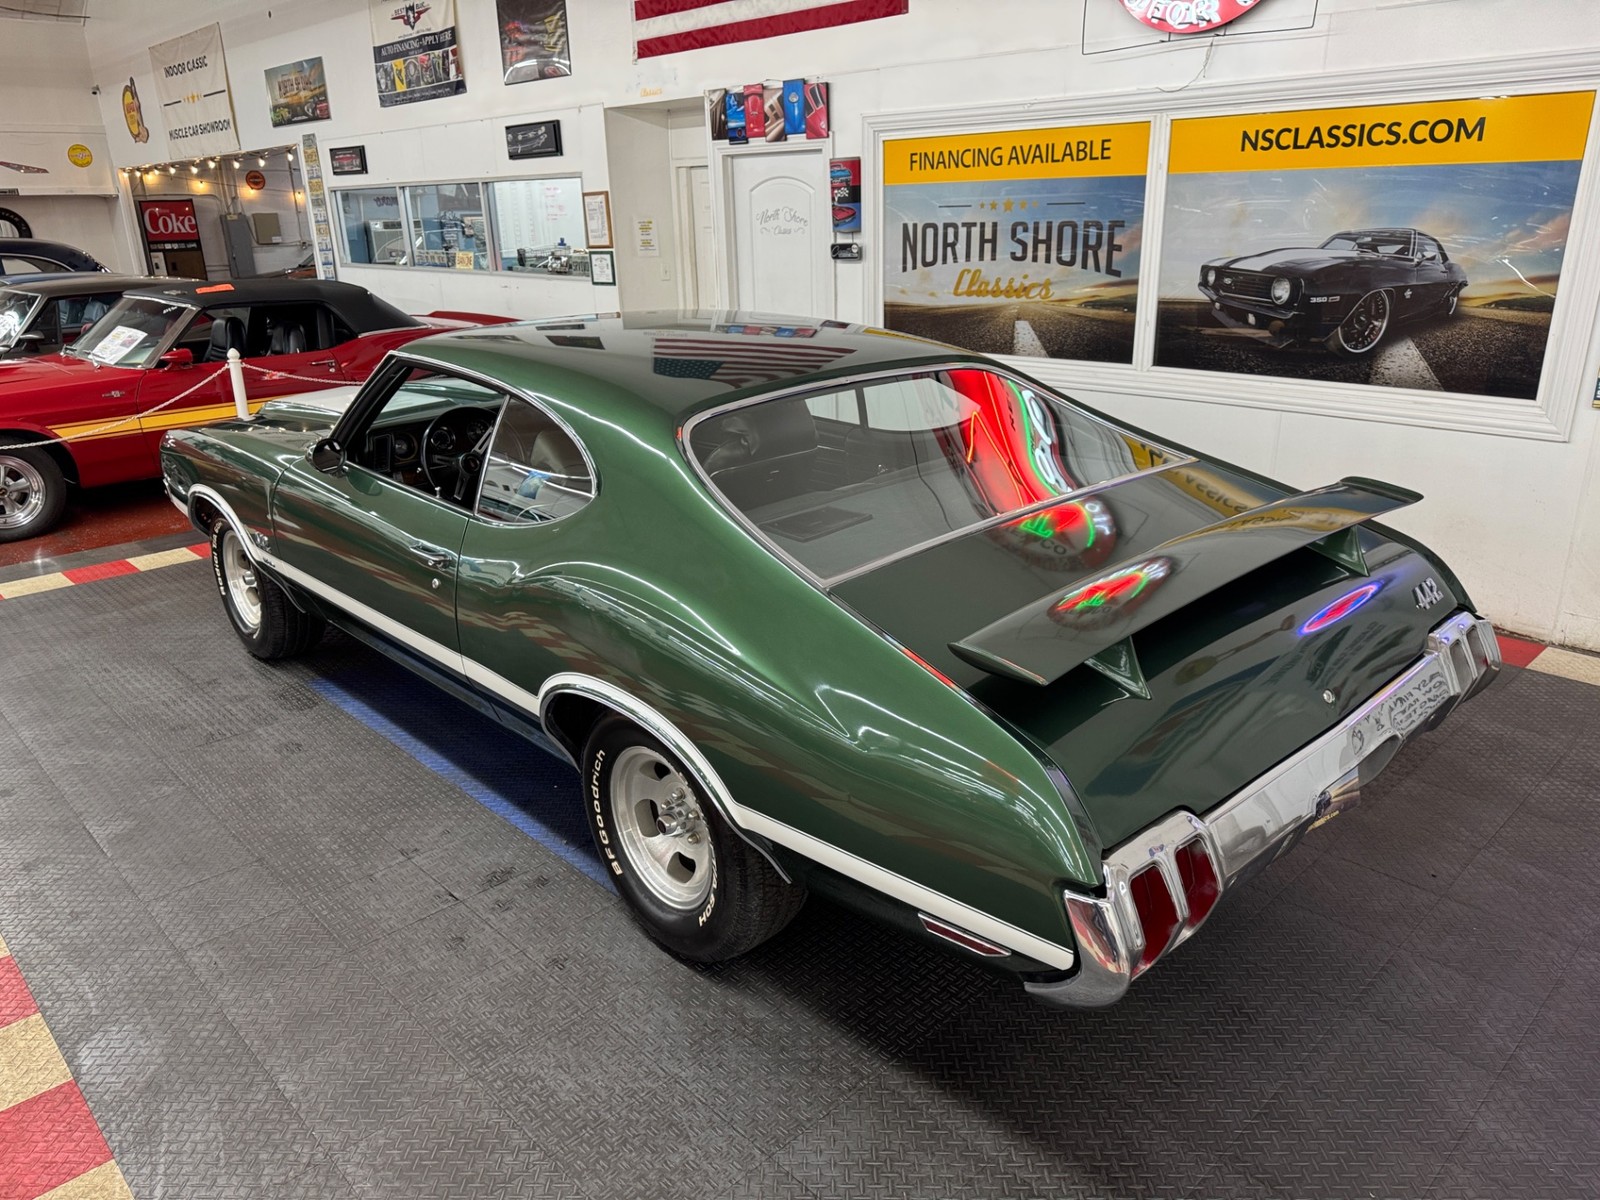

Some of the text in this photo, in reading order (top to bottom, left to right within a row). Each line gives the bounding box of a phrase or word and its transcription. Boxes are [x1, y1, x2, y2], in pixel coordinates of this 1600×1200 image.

[163, 56, 208, 78] INDOOR CLASSIC
[169, 128, 189, 141] MUSCLE
[188, 124, 199, 137] CAR
[1240, 116, 1487, 153] NSCLASSICS.COM
[909, 138, 1112, 171] FINANCING AVAILABLE
[144, 207, 197, 234] Coke
[755, 206, 808, 227] North Shore
[901, 220, 1125, 278] NORTH SHORE
[953, 268, 1054, 300] Classics
[213, 551, 225, 595] Radial
[1414, 577, 1444, 610] 442
[590, 749, 624, 876] BFGoodrich
